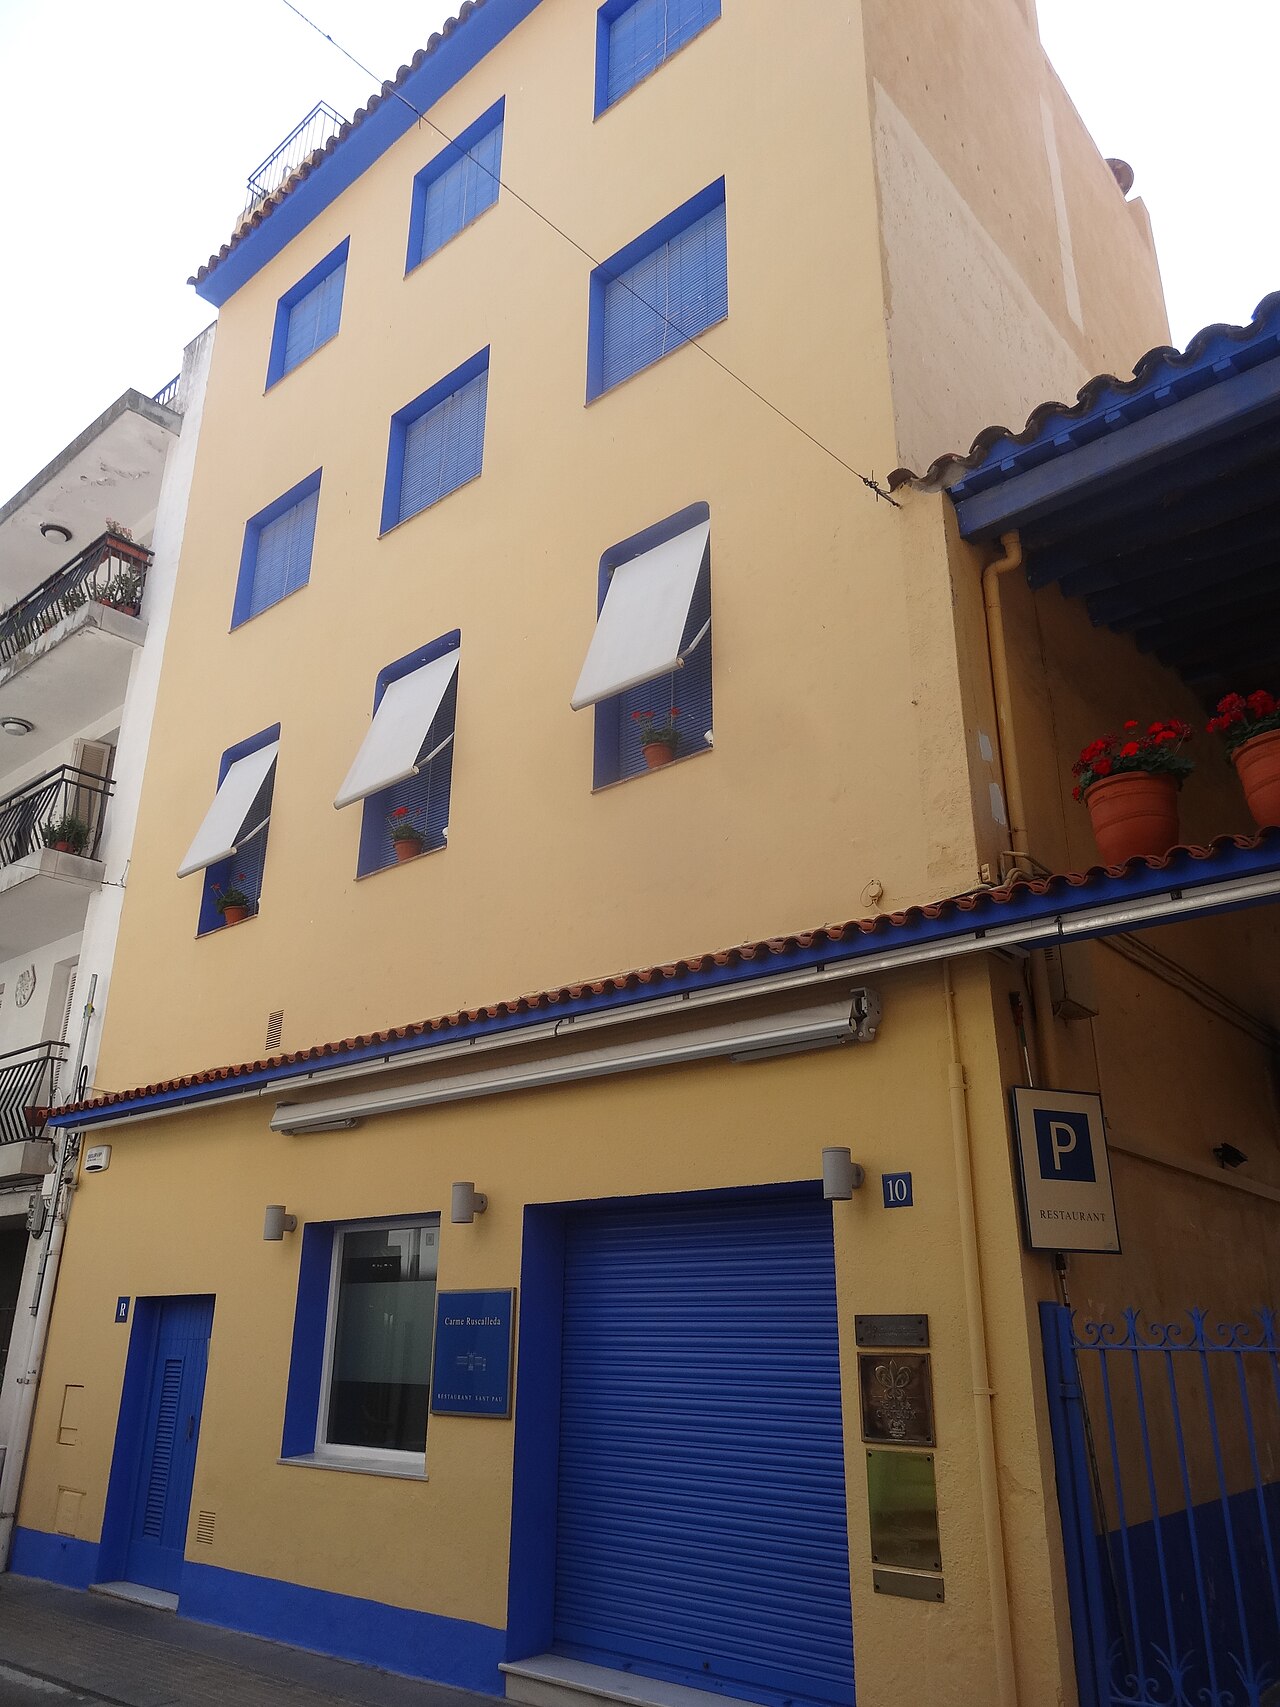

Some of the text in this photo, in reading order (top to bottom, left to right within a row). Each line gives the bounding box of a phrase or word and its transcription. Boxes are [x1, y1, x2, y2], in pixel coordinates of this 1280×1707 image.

[1049, 1121, 1077, 1171] P
[887, 1179, 907, 1202] 10
[1039, 1209, 1106, 1223] RESTAURANT
[119, 1302, 126, 1317] R
[444, 1316, 501, 1326] Carme Ruscalleda
[437, 1393, 472, 1401] RESTAURANT
